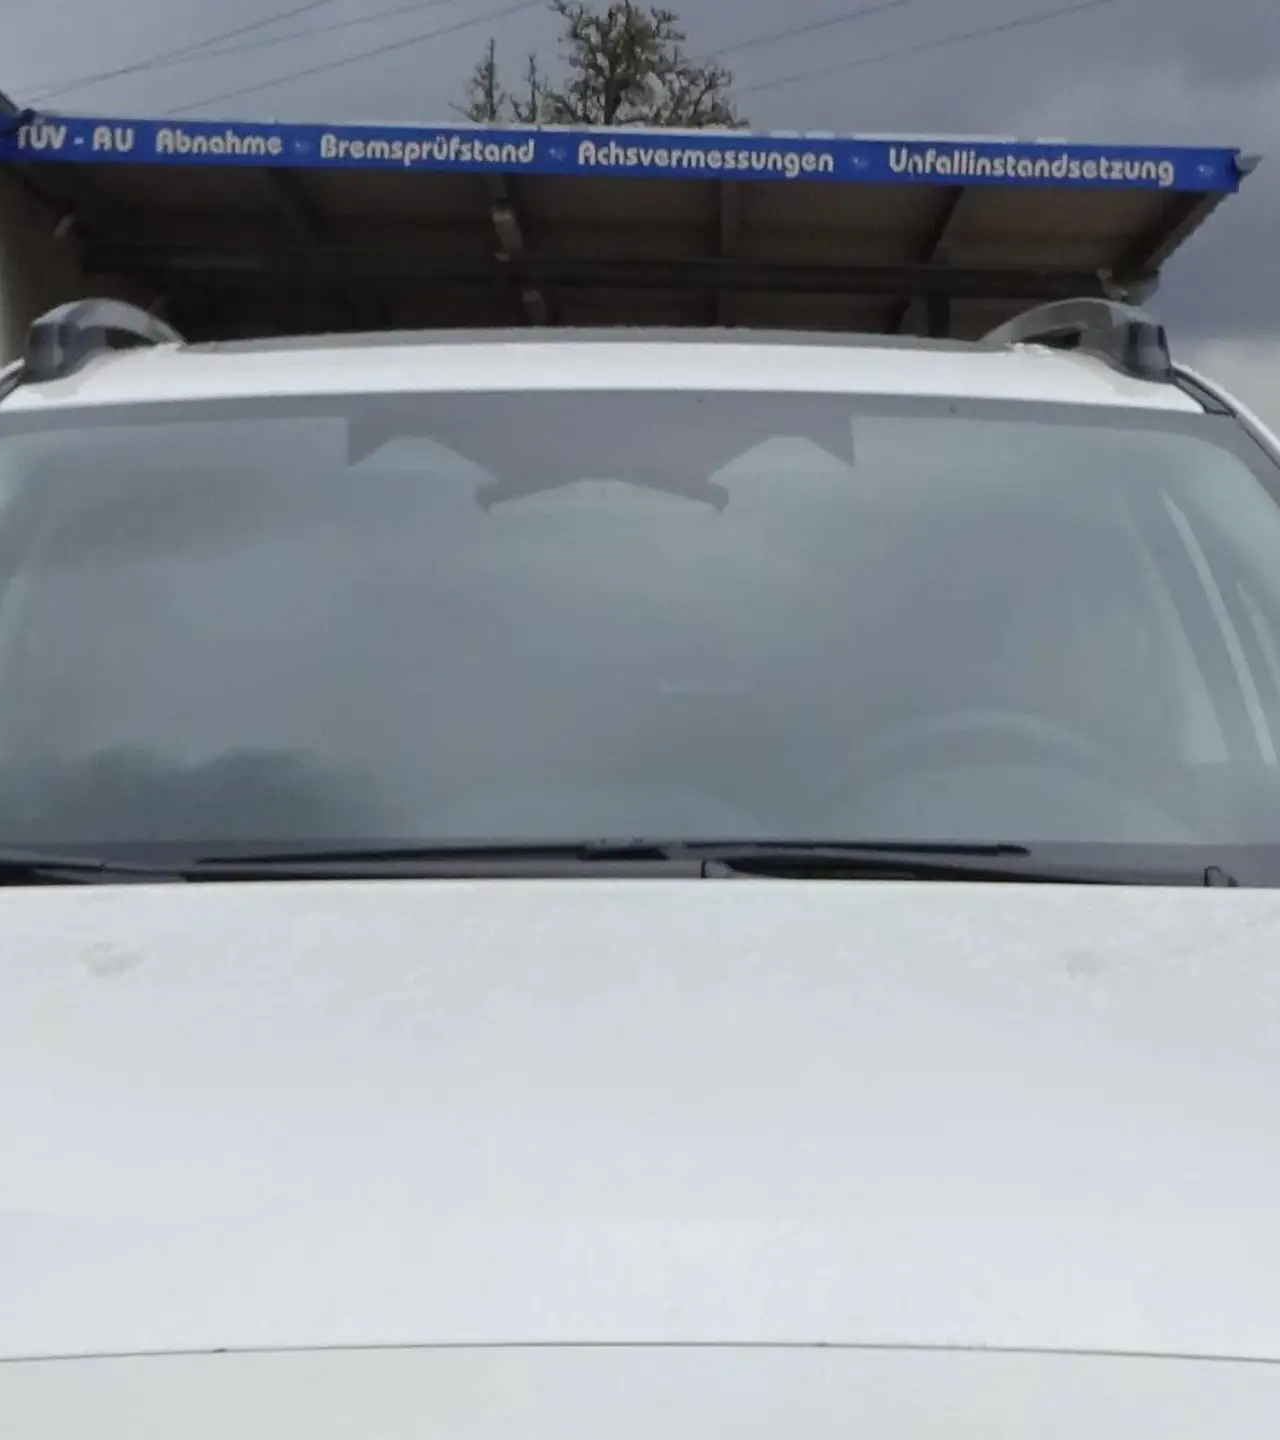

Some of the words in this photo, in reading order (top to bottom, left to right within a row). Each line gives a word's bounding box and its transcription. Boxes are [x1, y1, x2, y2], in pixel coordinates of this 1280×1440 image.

[92, 125, 135, 151] AU
[155, 128, 284, 156] Abnahme
[320, 133, 536, 167] Bremsprüfstand
[577, 139, 835, 178] Achsvermessungen
[888, 147, 1176, 186] Unfallinstandsetzung
